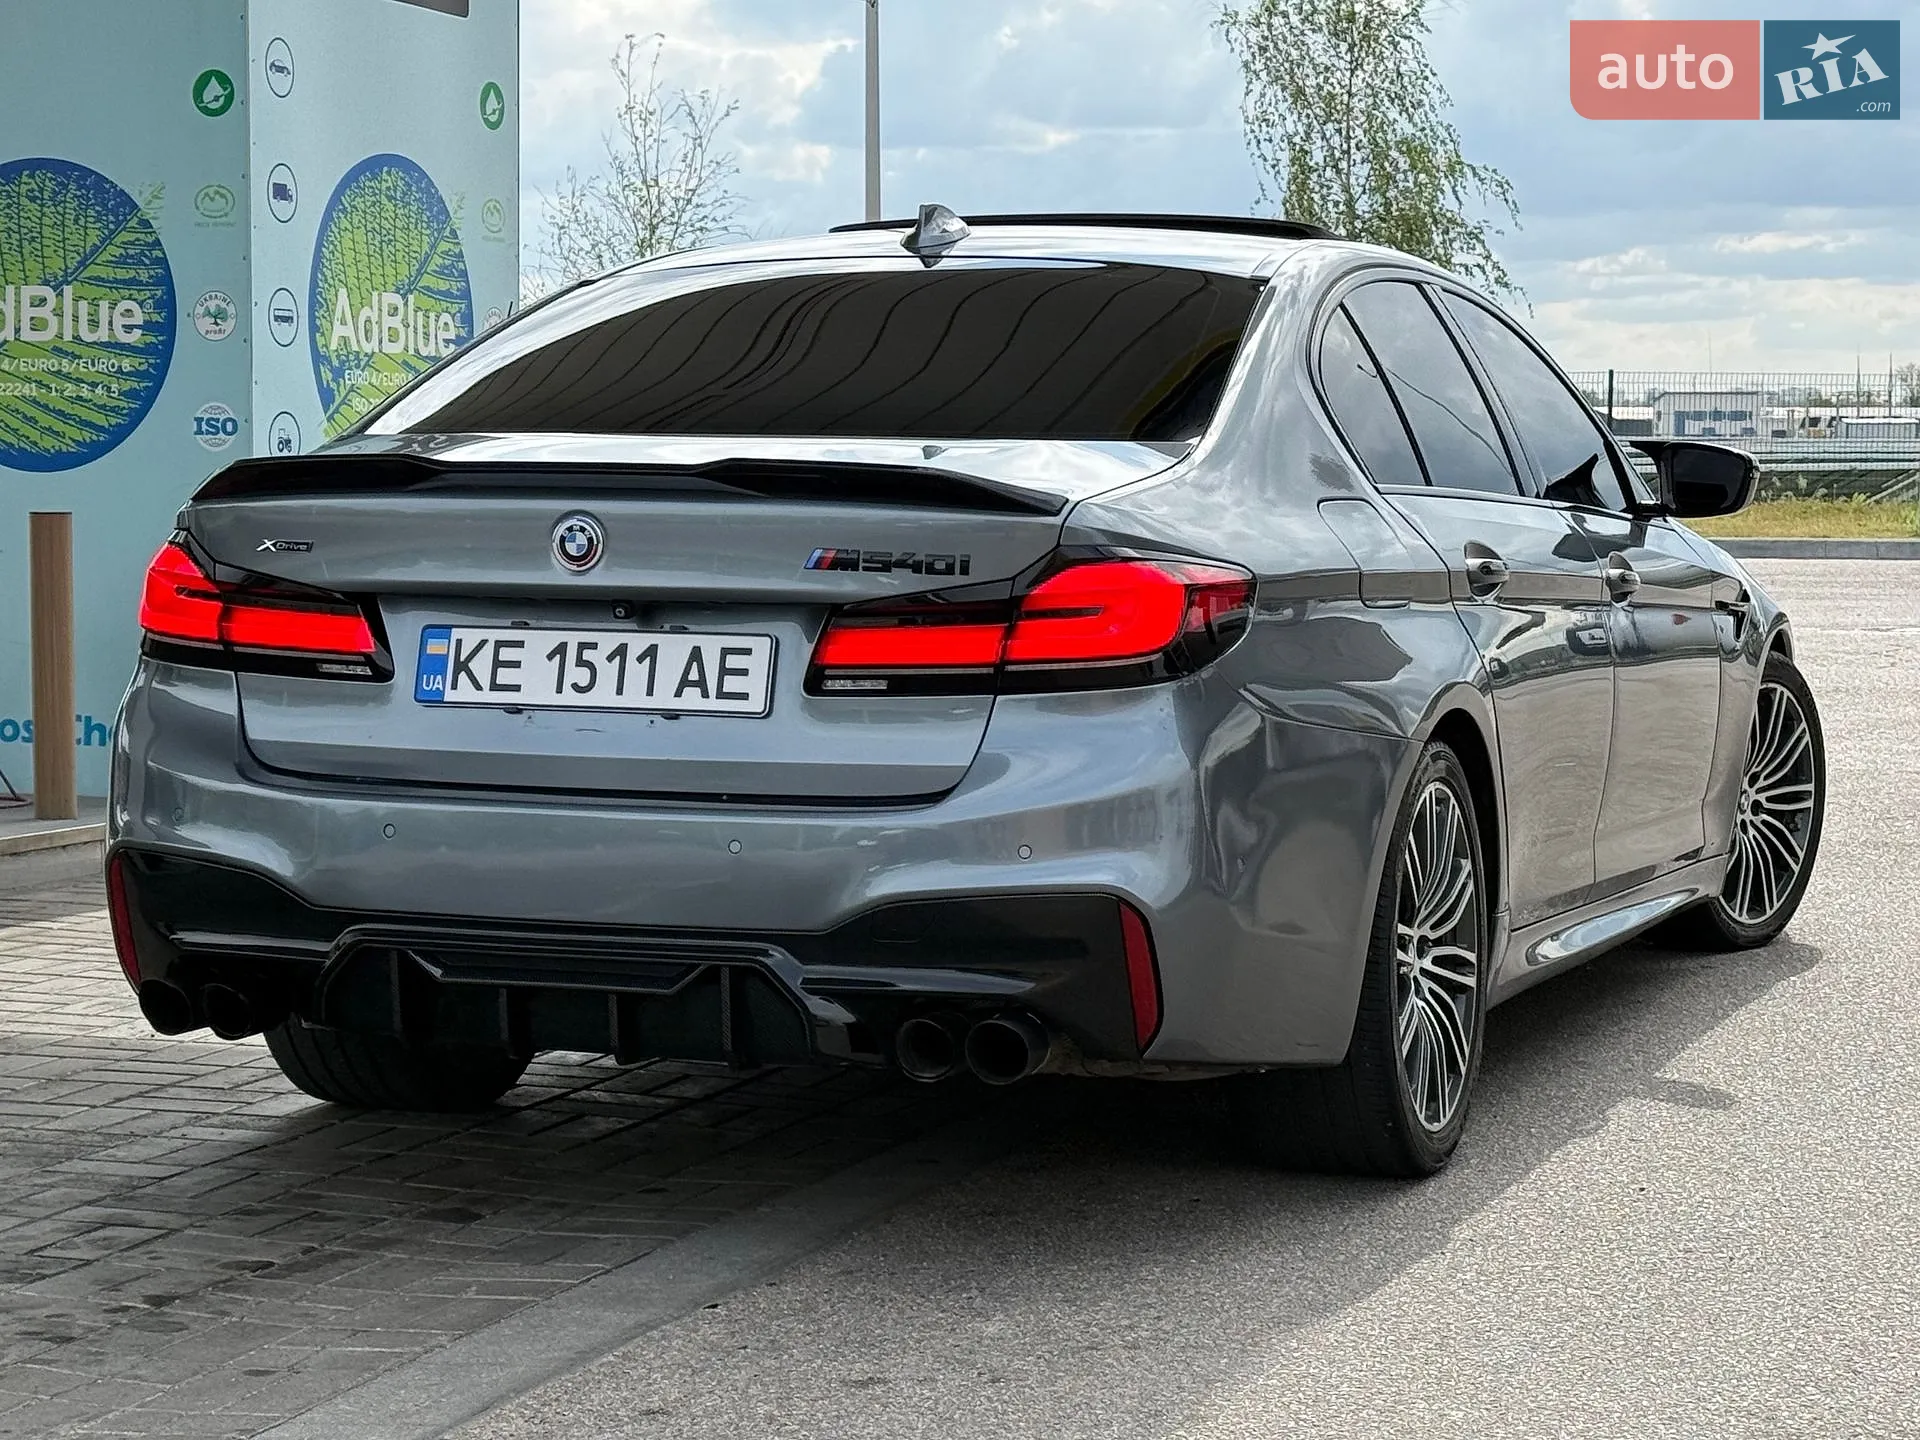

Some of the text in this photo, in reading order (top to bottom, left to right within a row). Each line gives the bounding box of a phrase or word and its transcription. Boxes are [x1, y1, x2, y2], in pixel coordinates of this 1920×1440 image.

[330, 287, 456, 357] AdBlue
[193, 416, 239, 436] ISO
[422, 674, 443, 692] UA
[450, 638, 753, 701] KE 1511 AE
